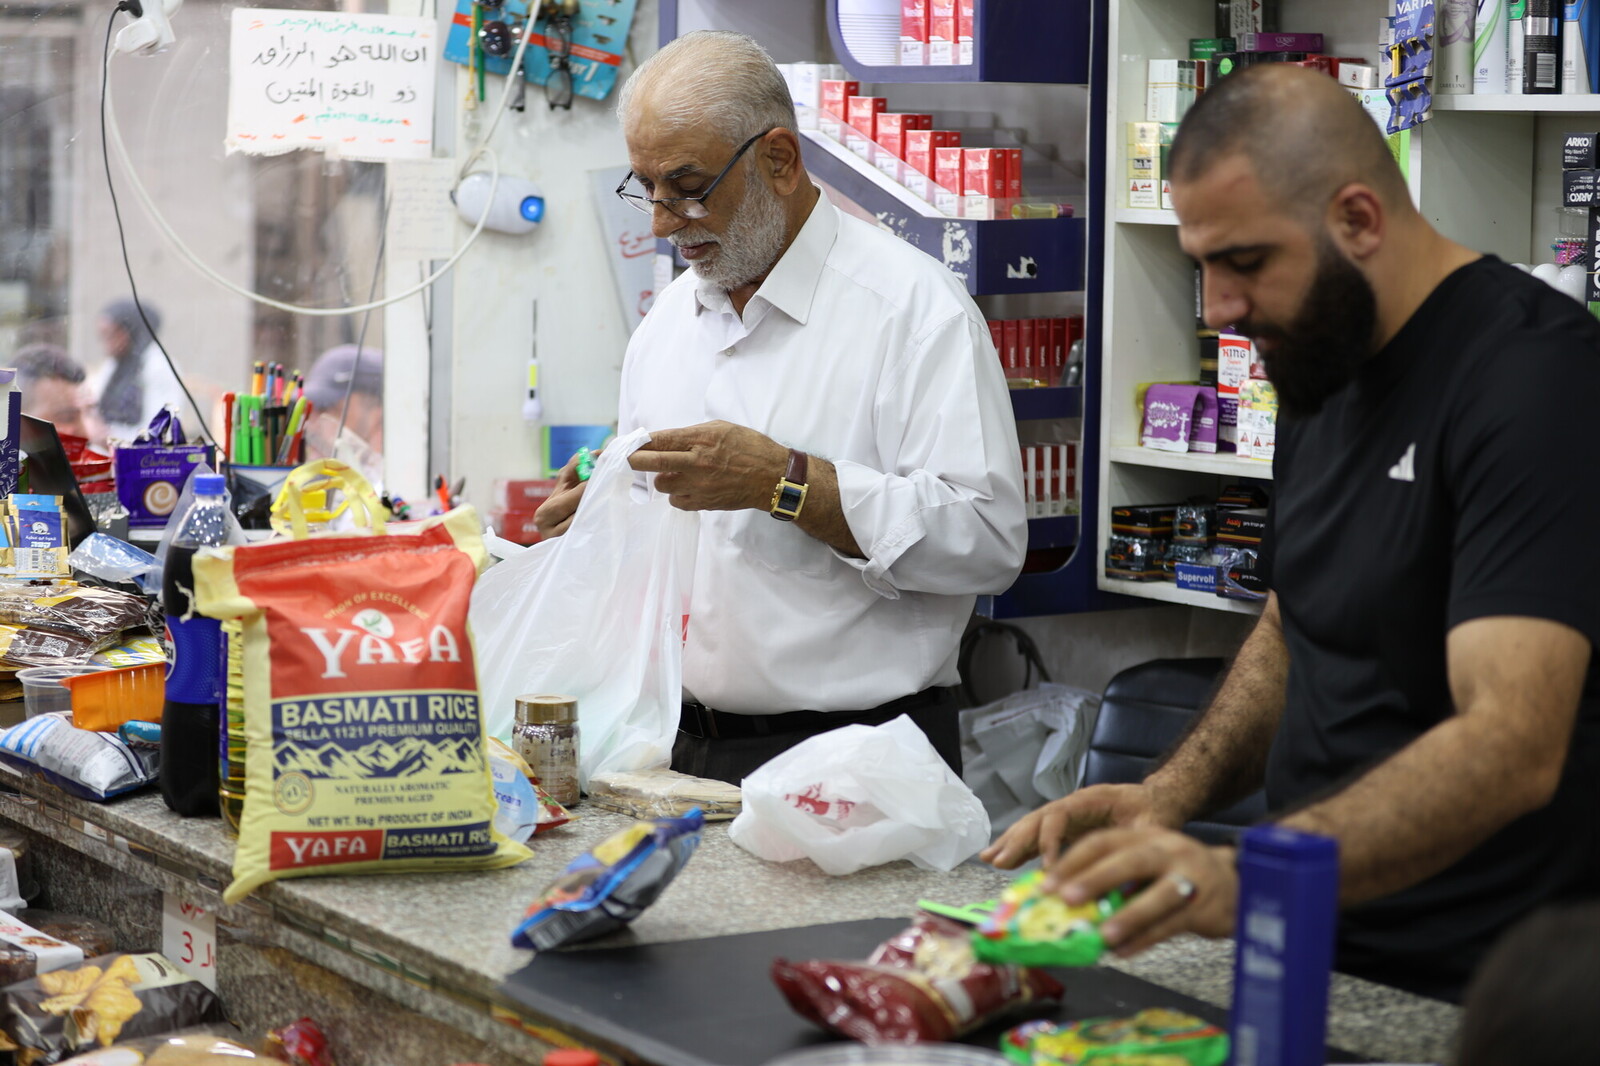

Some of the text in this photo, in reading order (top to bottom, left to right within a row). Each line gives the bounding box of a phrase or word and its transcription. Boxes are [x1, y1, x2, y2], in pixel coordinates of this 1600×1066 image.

[324, 44, 358, 69] هو
[359, 43, 397, 62] الله
[1565, 137, 1590, 147] ARKO
[1569, 192, 1594, 202] ARKO
[140, 454, 180, 468] Cadbury
[1178, 571, 1215, 584] Supervolt
[300, 624, 461, 679] YAFA
[281, 696, 477, 727] BASMATI RICE
[368, 723, 433, 737] PREMIUM
[435, 722, 477, 735] QUALITY
[308, 816, 329, 827] NET
[378, 813, 428, 825] PRODUCT
[431, 812, 444, 822] OF
[447, 810, 472, 820] INDIA
[284, 836, 367, 864] YAFA
[387, 831, 464, 848] BASMATI
[181, 931, 193, 963] 3
